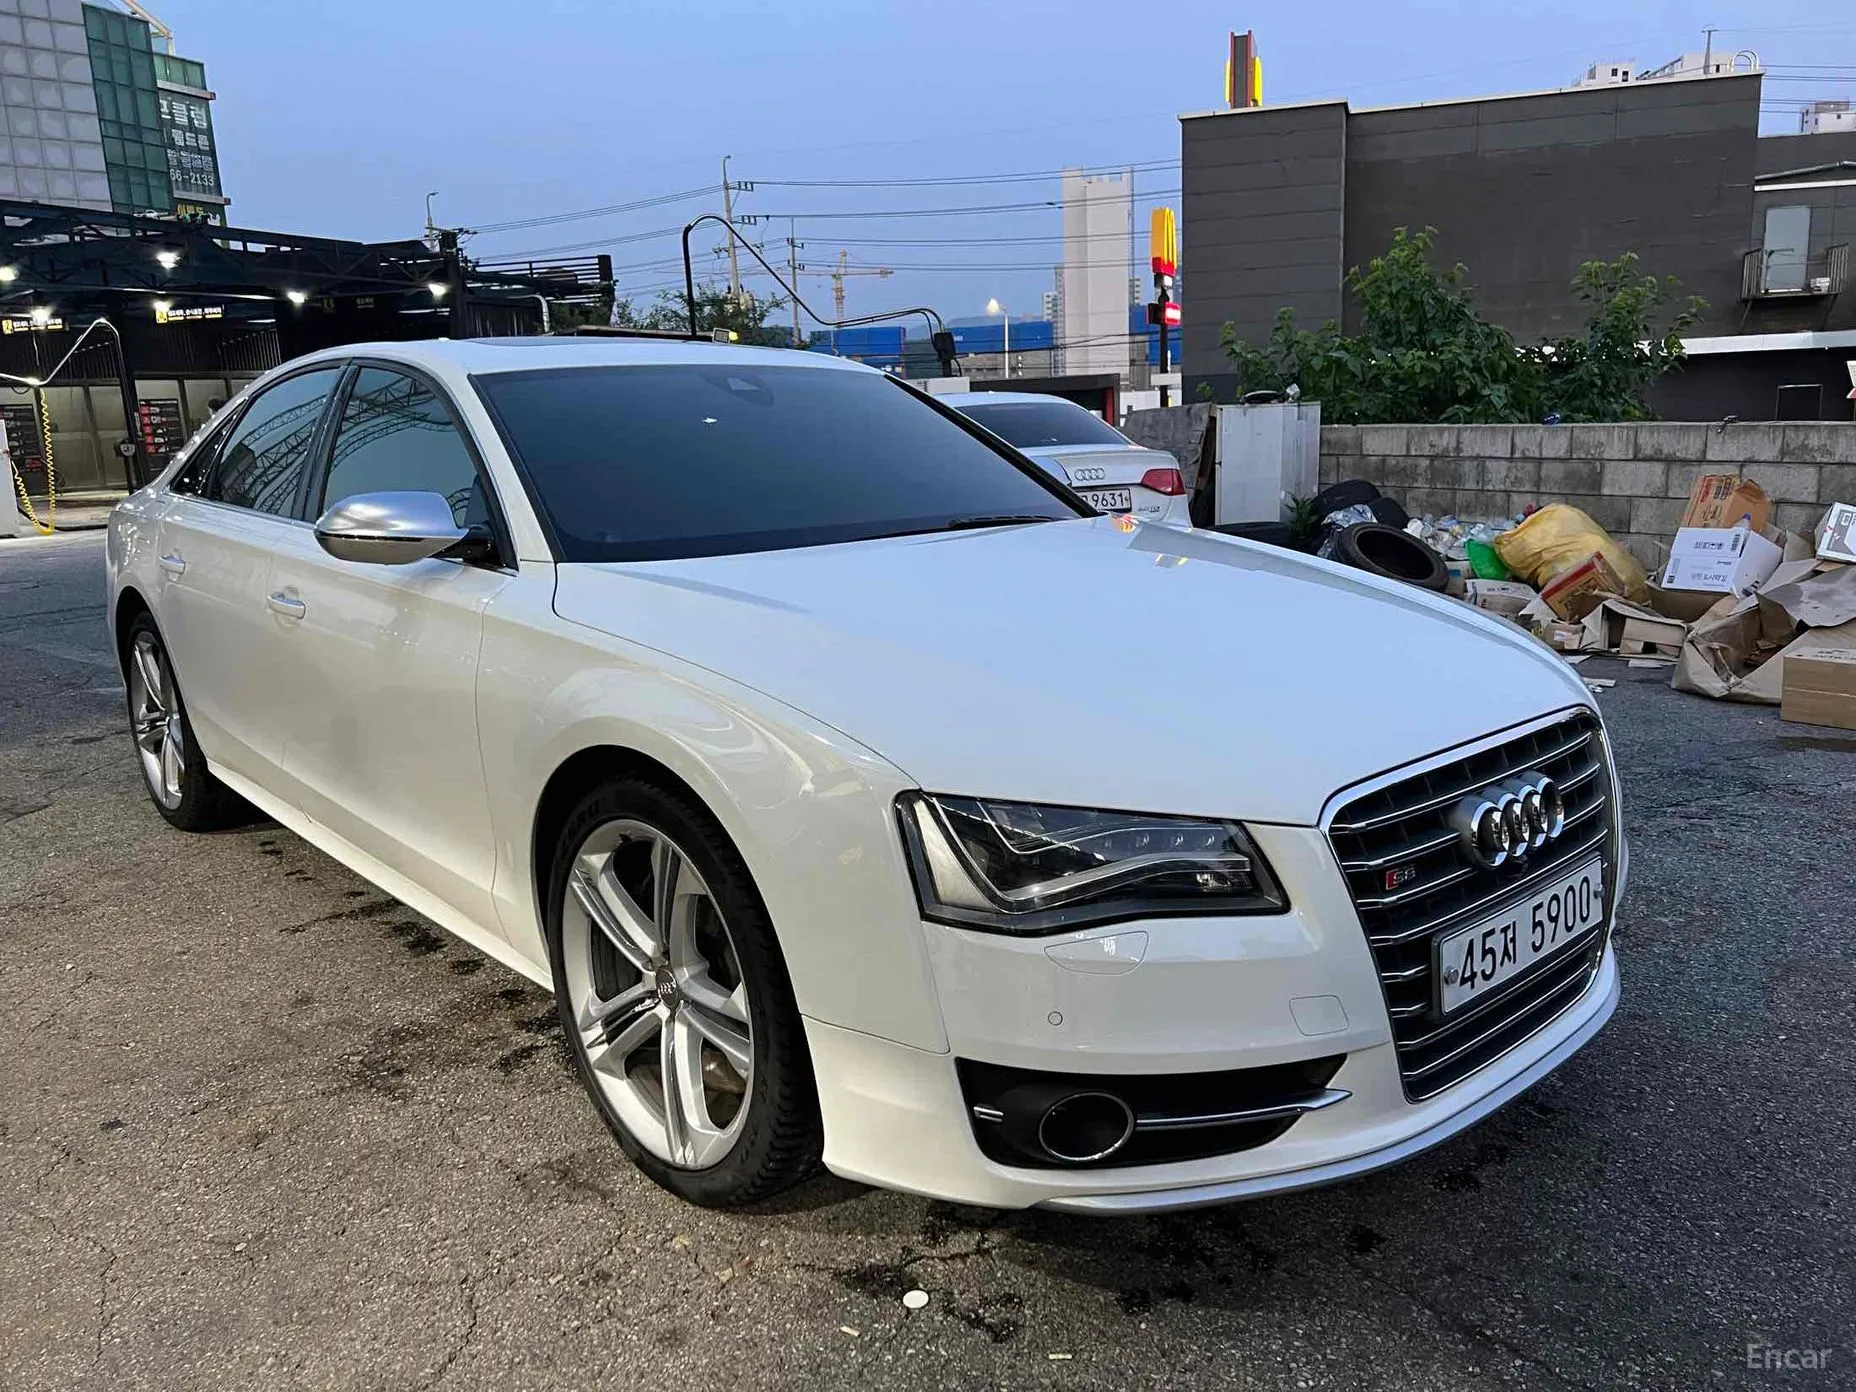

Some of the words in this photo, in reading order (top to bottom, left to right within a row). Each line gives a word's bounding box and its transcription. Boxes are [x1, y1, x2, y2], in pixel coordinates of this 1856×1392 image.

[1091, 492, 1124, 508] 9631
[1459, 920, 1517, 990] 45저
[1531, 875, 1590, 953] 5900
